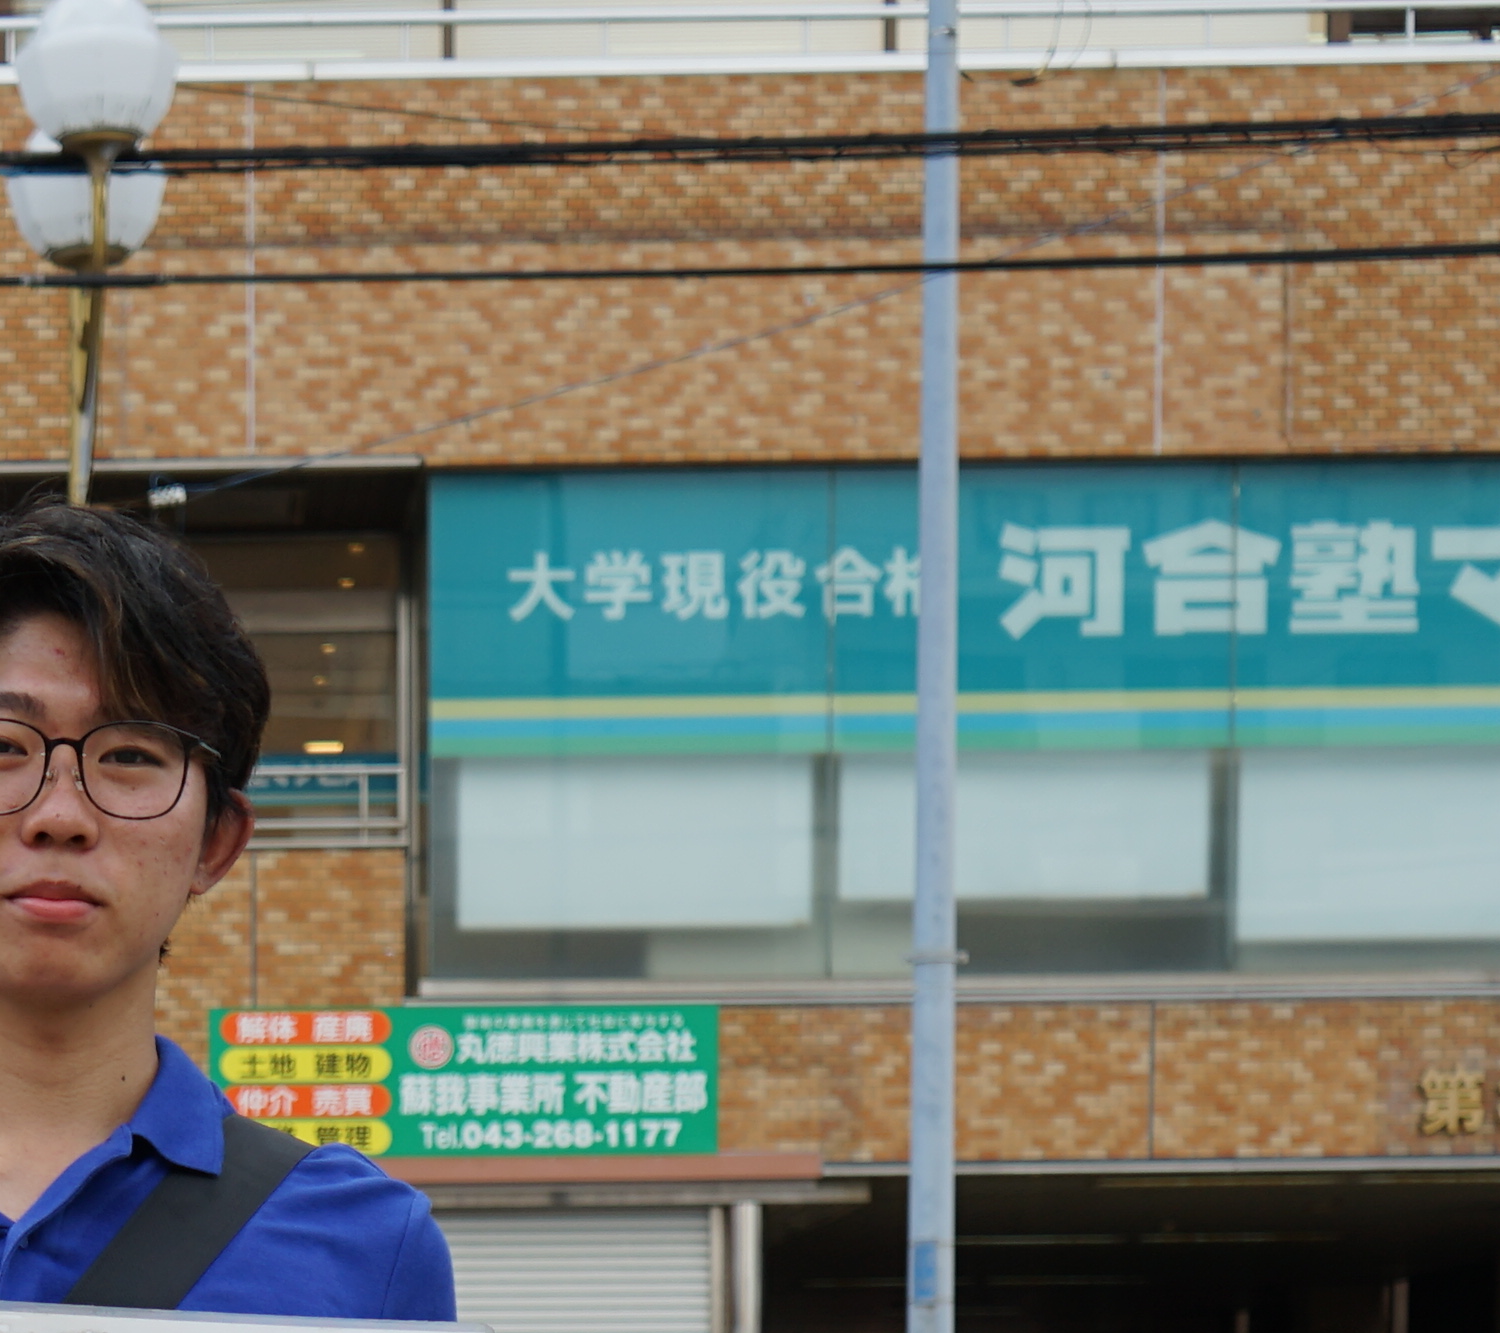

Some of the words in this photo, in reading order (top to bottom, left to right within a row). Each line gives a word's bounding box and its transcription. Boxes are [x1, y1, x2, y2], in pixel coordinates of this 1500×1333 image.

[239, 1053, 295, 1079] 土地
[315, 1052, 373, 1079] 建物
[236, 1085, 298, 1116] 仲介
[316, 1126, 372, 1148] 管理
